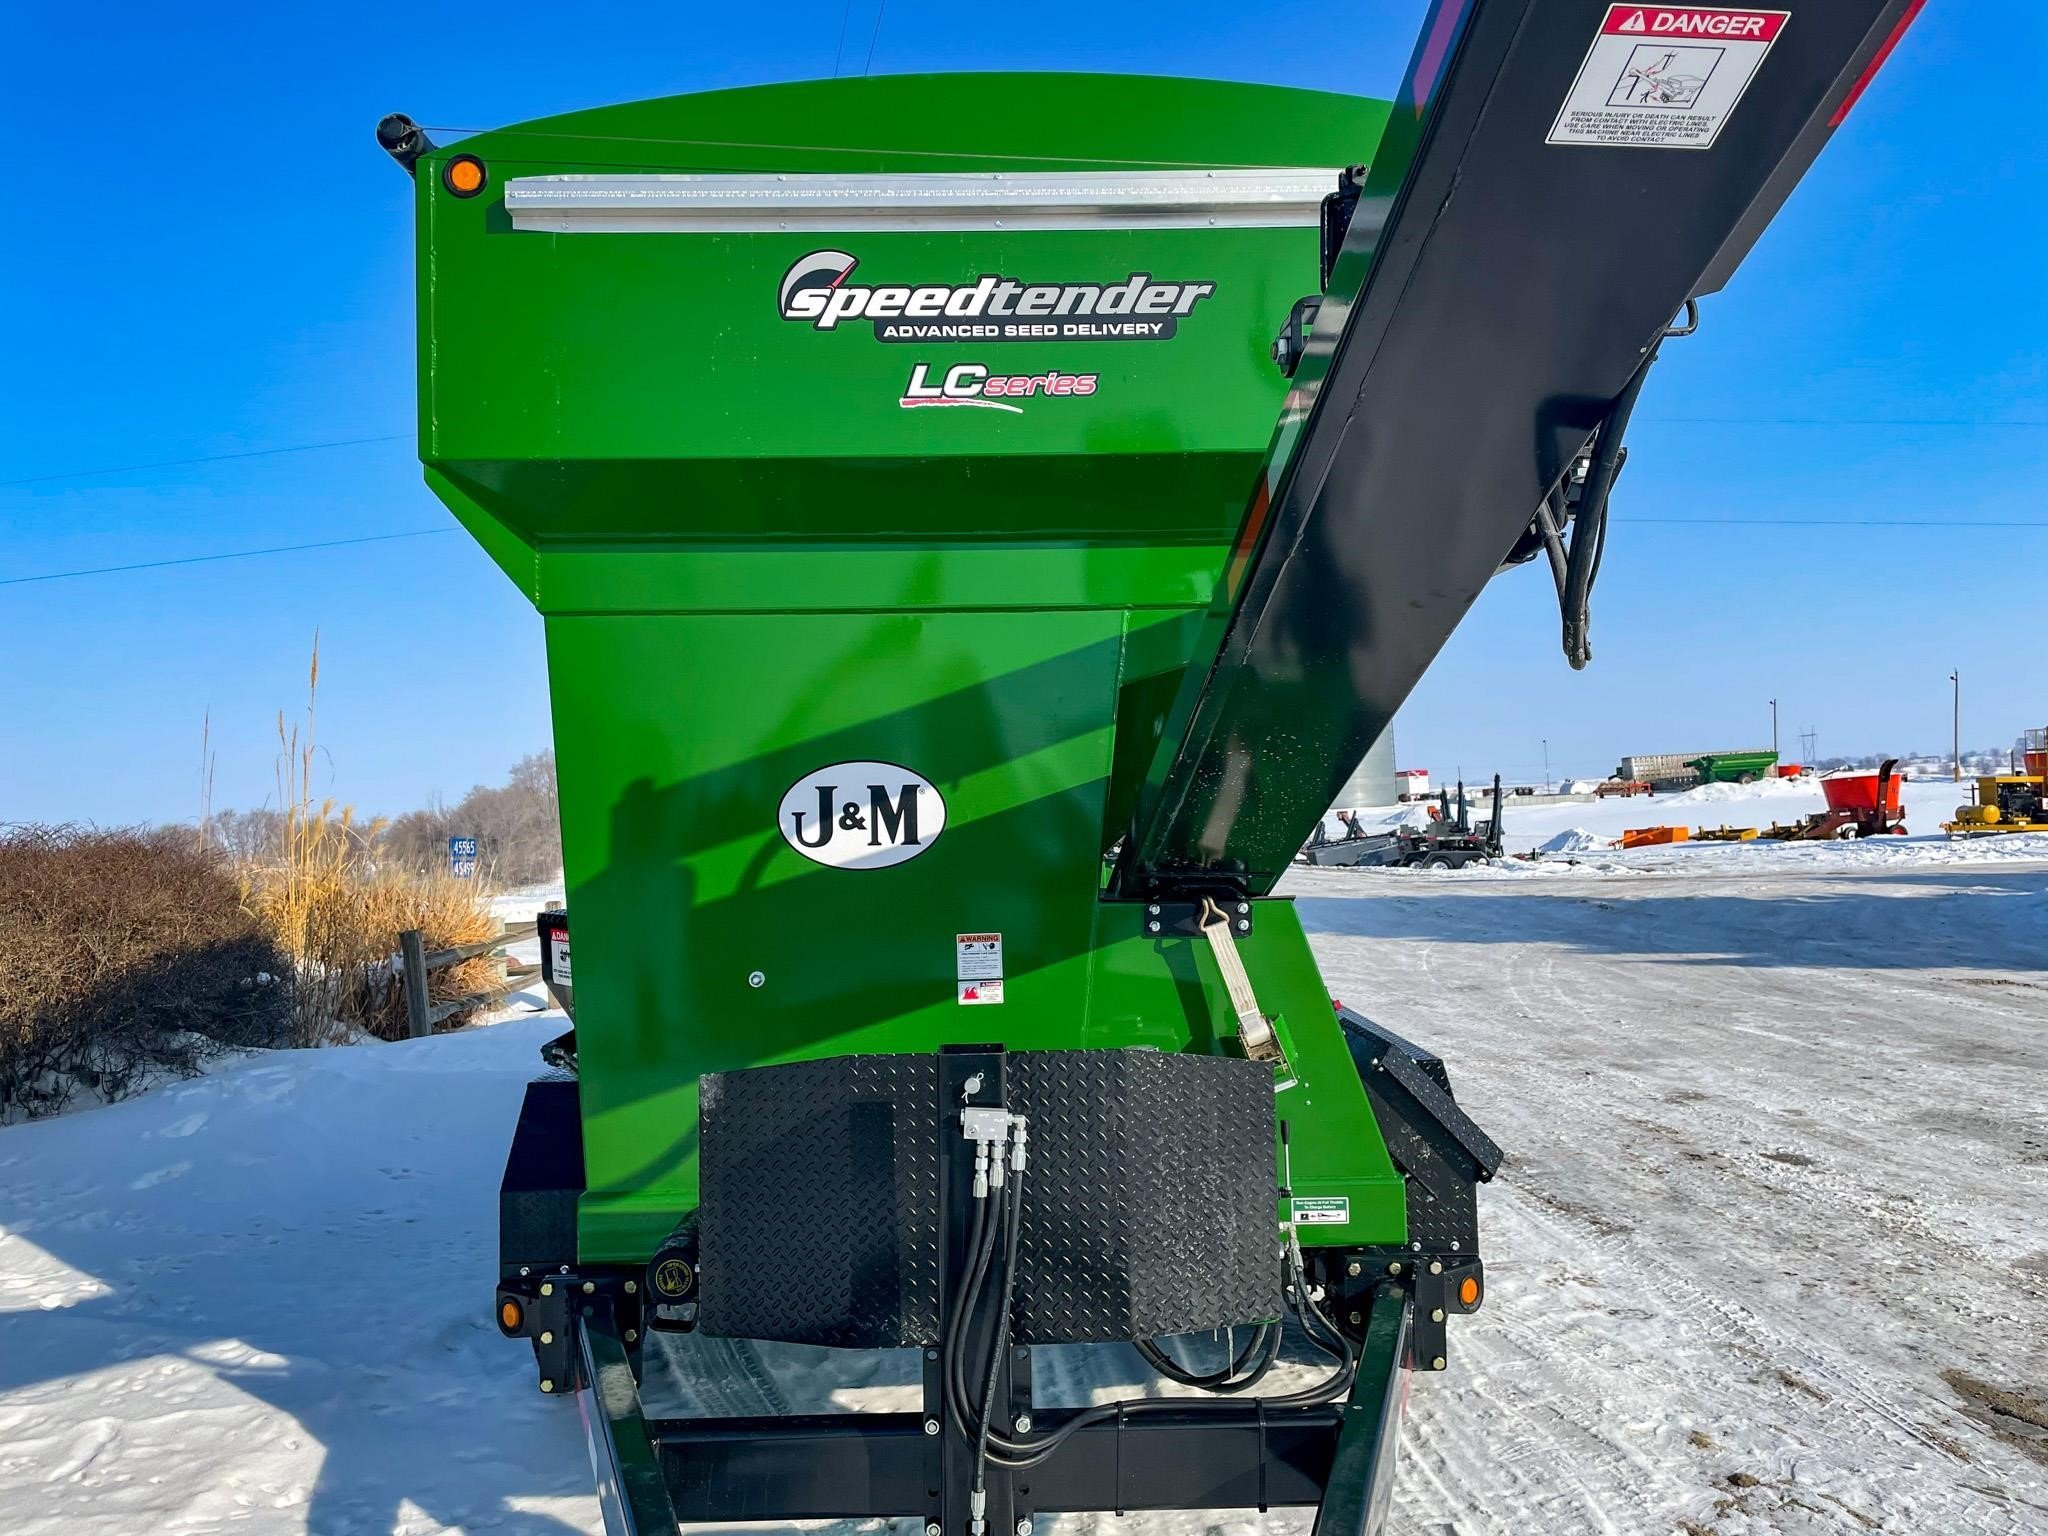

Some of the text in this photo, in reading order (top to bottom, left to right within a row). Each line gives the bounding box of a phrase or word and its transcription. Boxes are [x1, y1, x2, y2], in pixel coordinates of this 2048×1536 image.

[1651, 13, 1765, 36] DANGER
[883, 322, 1163, 338] ADVANCED SEED DELIVERY
[984, 373, 1097, 396] series
[454, 840, 475, 854] 45565
